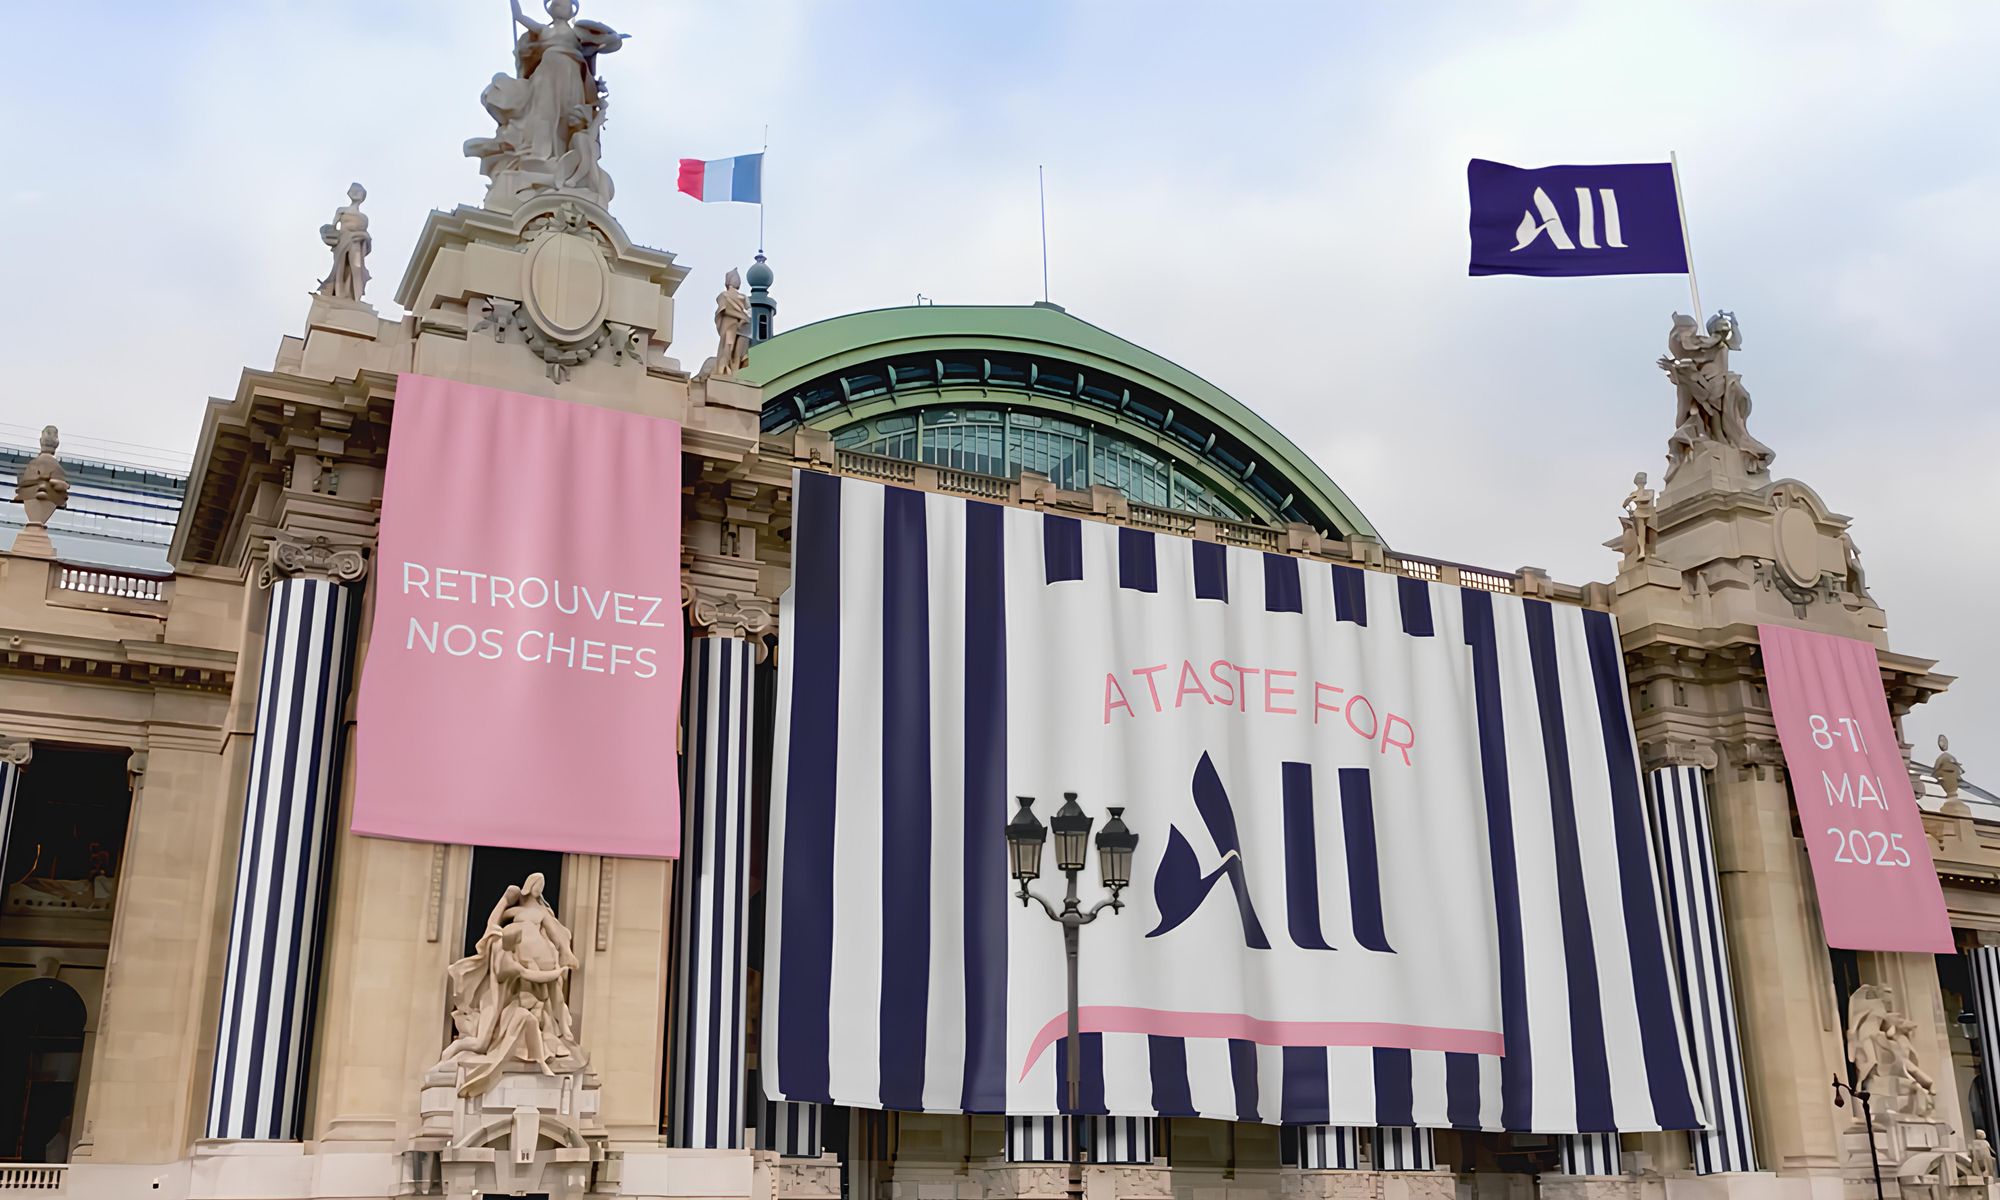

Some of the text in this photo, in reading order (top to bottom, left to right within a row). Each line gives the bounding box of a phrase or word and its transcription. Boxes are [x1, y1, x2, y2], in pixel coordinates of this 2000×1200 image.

[403, 561, 665, 628] RETROUVEZ
[406, 617, 658, 679] NOS CHEFS
[1103, 658, 1416, 767] A TASTE FOR
[1808, 714, 1868, 755] 8-11
[1821, 769, 1889, 811] MAI
[1827, 827, 1911, 868] 2025
